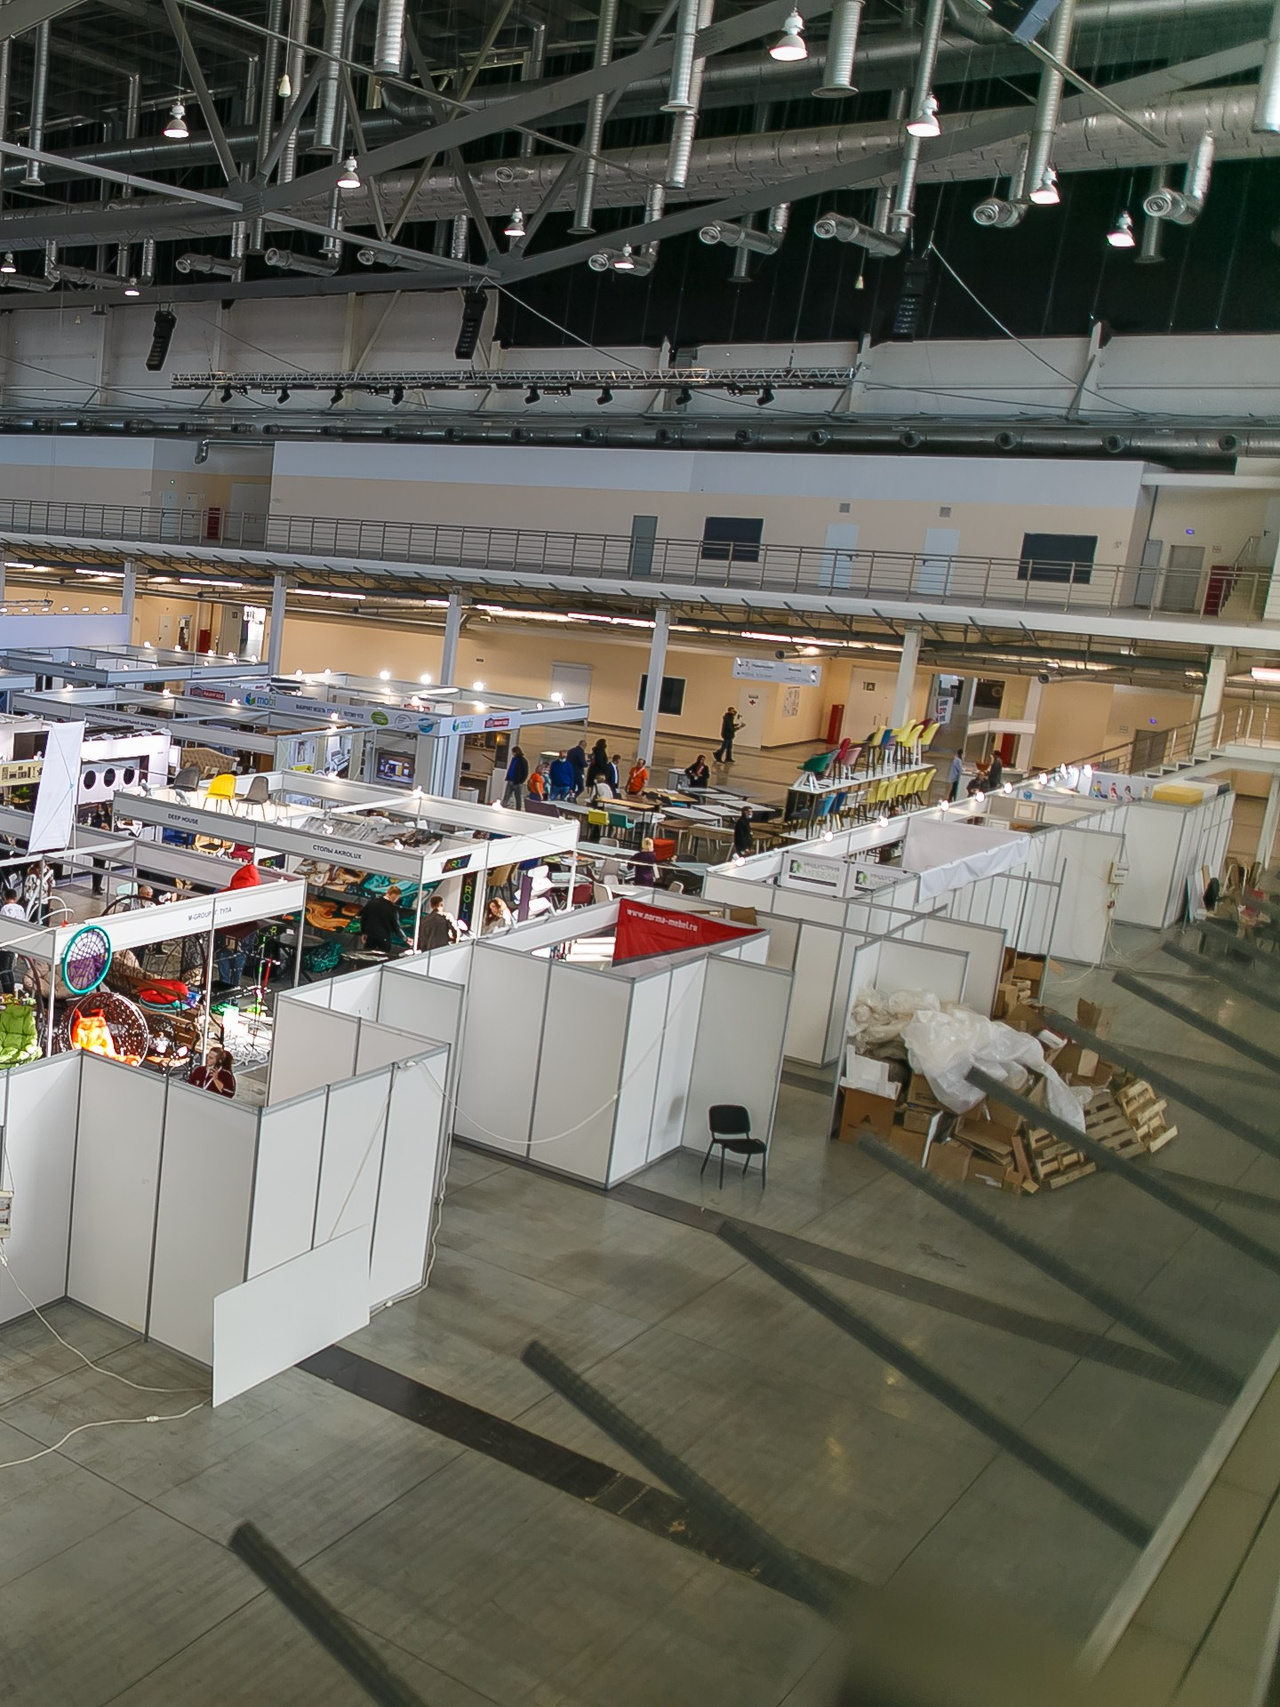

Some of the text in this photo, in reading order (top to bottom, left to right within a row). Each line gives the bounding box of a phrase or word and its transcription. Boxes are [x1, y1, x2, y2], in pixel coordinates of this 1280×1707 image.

[256, 695, 277, 707] mobi
[167, 812, 199, 825] DEEP HOUSE
[312, 844, 362, 860] СТОЛЫ AKROLUX
[626, 908, 699, 932] www.norma-mebel.ru
